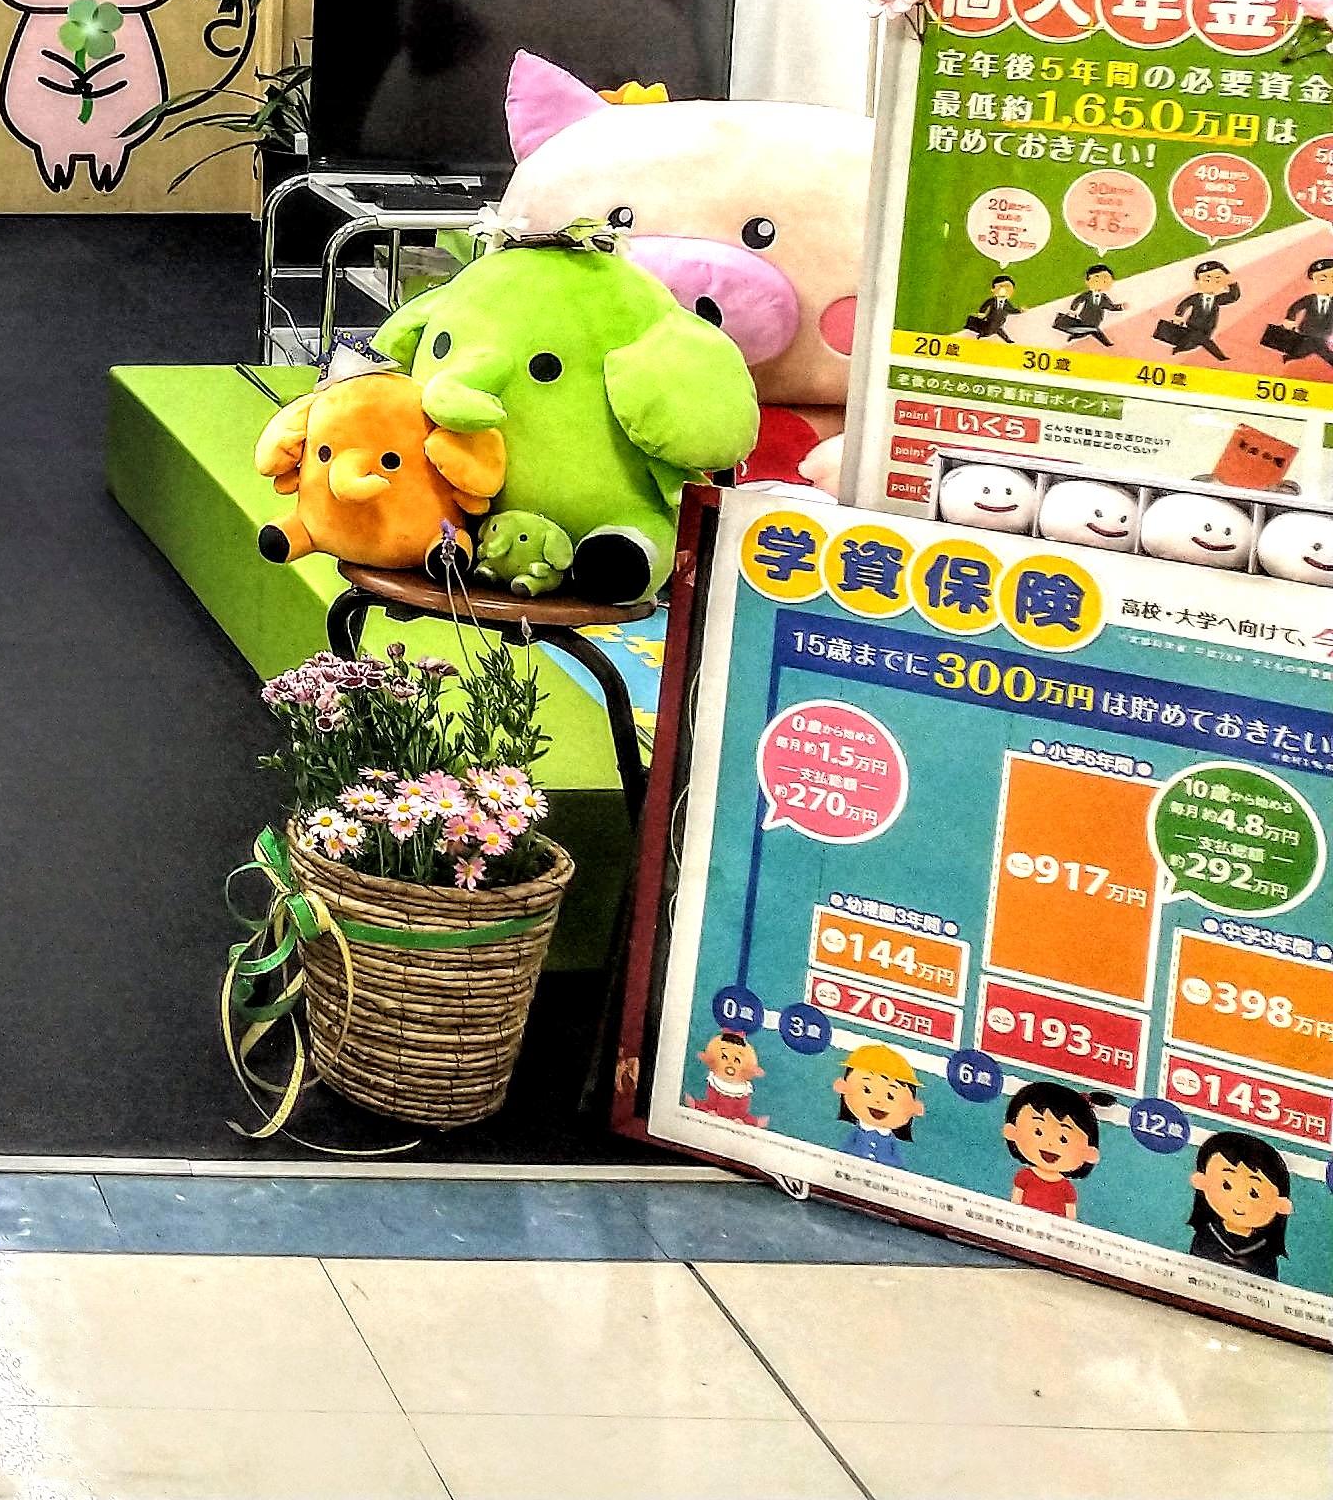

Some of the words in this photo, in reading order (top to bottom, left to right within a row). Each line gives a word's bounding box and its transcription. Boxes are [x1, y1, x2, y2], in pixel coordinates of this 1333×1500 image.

[933, 48, 1333, 106] 定年後5年間の必要資金
[926, 123, 1159, 169] 貯めておきたい!
[913, 337, 961, 358] 20歳
[1021, 350, 1072, 373] 30歳
[1136, 365, 1188, 387] 40歳
[1255, 380, 1310, 403] 50歳
[898, 408, 930, 424] point
[932, 407, 943, 428] 1
[956, 410, 1027, 439] いくら
[894, 445, 925, 460] point
[891, 480, 923, 495] point
[752, 522, 1088, 634] 学資保険
[1120, 598, 1307, 648] 高校・大学へ向けて、
[1046, 741, 1134, 777] 小学6年間
[773, 781, 879, 827] 約270万円
[1034, 854, 1148, 908] 917万円
[1169, 852, 1290, 901] 約292万円
[844, 894, 944, 935] 幼稚園3年間
[848, 931, 956, 988] 144万円
[1221, 920, 1314, 959] 中学3年間
[847, 989, 934, 1036] 70万円
[1213, 980, 1333, 1043] 398万円
[1018, 1011, 1135, 1071] 193万円
[959, 1063, 993, 1088] 6歳
[1136, 1109, 1185, 1139] 12歳
[1203, 1073, 1328, 1138] 143万円
